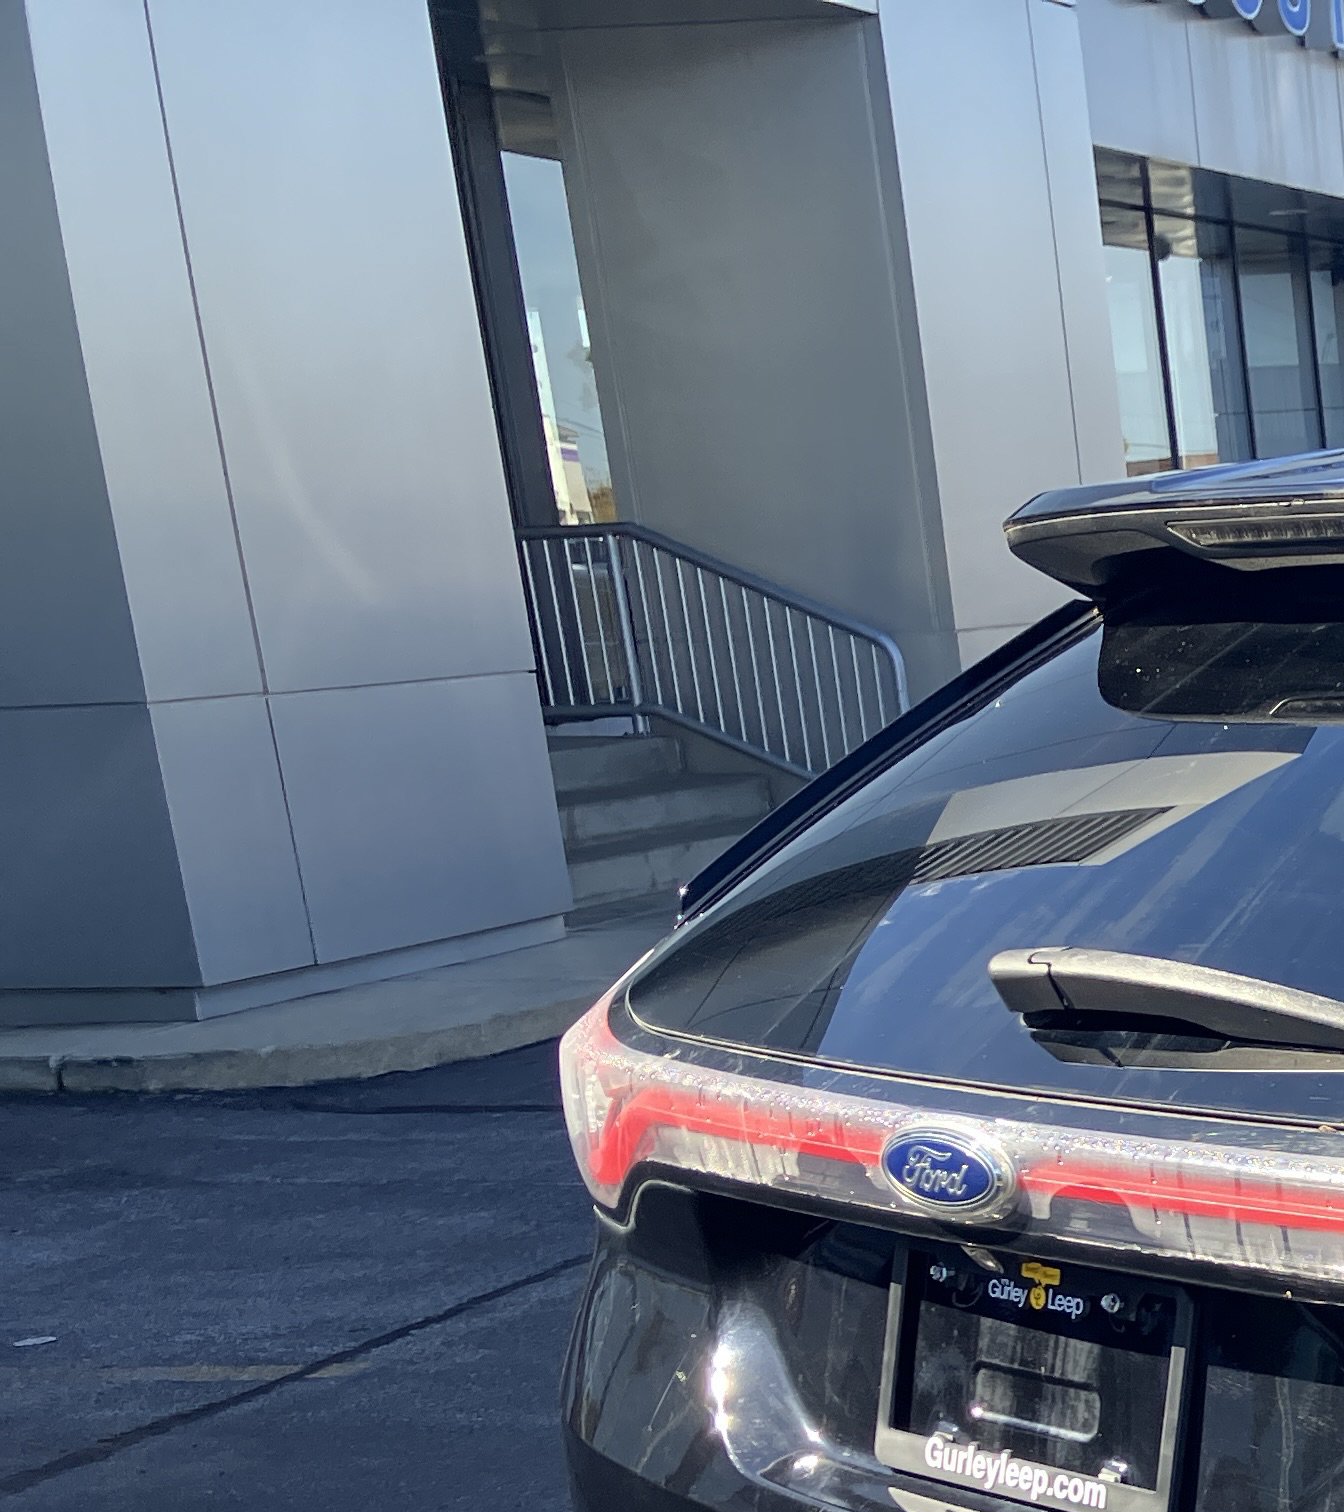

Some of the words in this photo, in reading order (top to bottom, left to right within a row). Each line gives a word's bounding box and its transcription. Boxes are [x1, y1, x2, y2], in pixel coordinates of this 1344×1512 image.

[901, 1145, 969, 1197] Ford
[987, 1280, 1029, 1309] Gurley
[1046, 1288, 1084, 1320] Leep
[924, 1435, 1108, 1510] Gurleyleep.com
